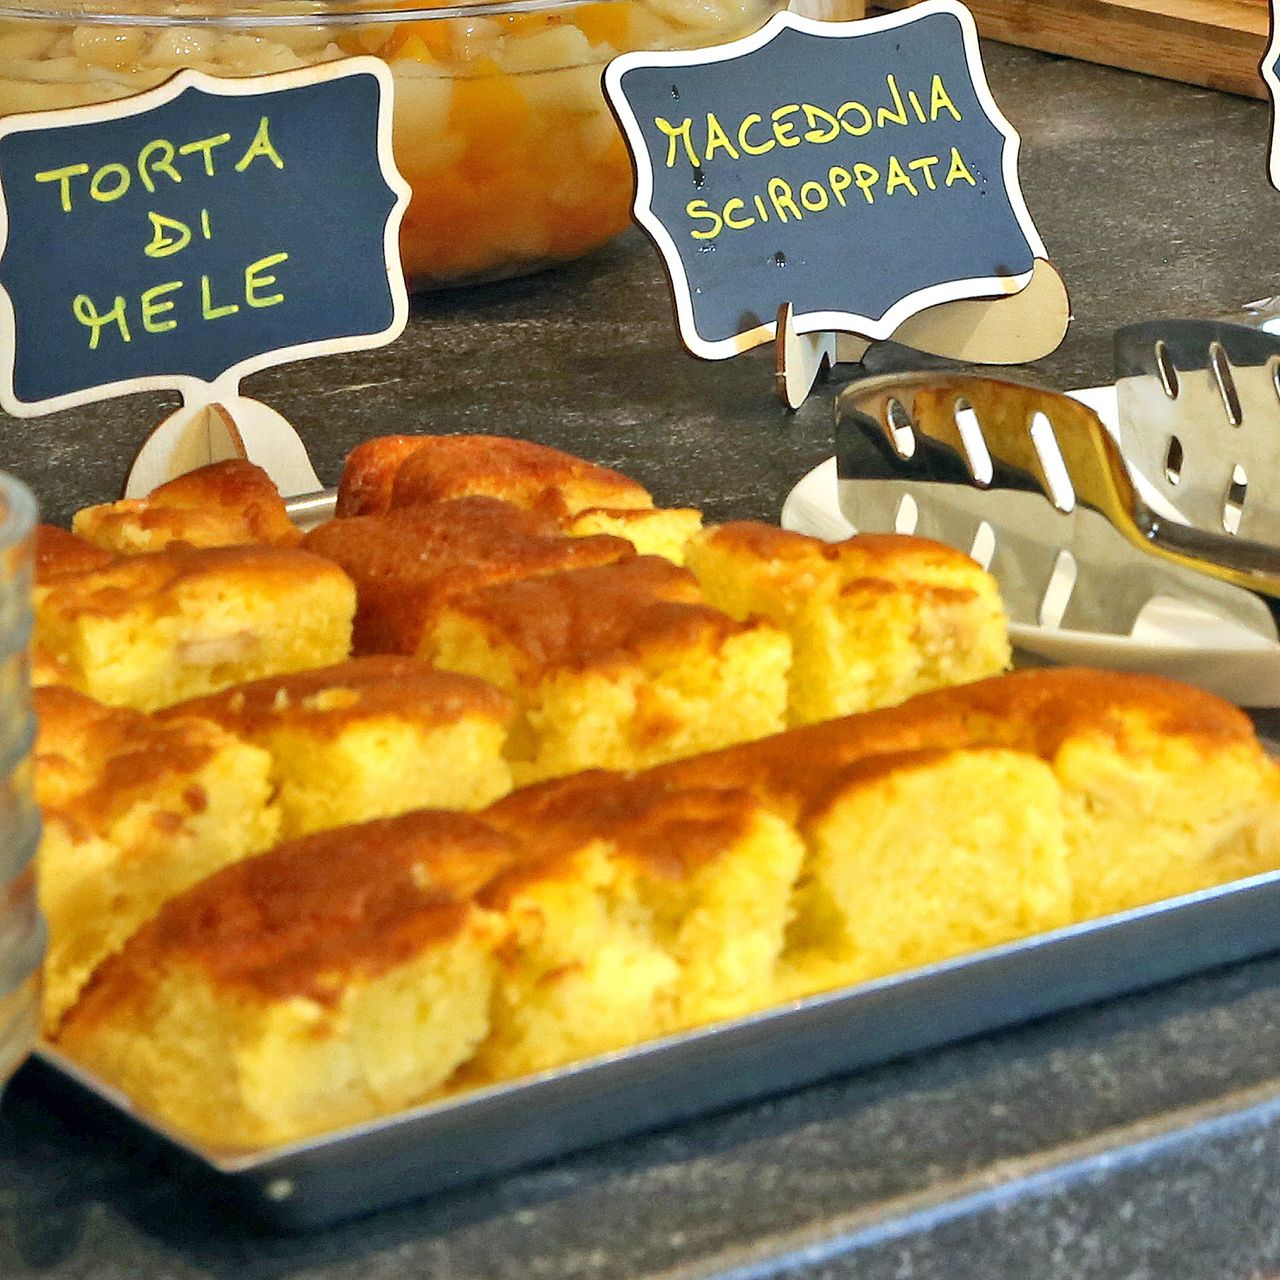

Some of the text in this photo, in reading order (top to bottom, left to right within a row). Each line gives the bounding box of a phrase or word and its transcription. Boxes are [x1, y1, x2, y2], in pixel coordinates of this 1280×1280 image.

[35, 116, 284, 212] TORTA
[655, 74, 962, 168] MACEDONIA
[144, 209, 211, 258] DI
[685, 147, 977, 240] SCIROPPATA
[72, 252, 289, 350] MELE
